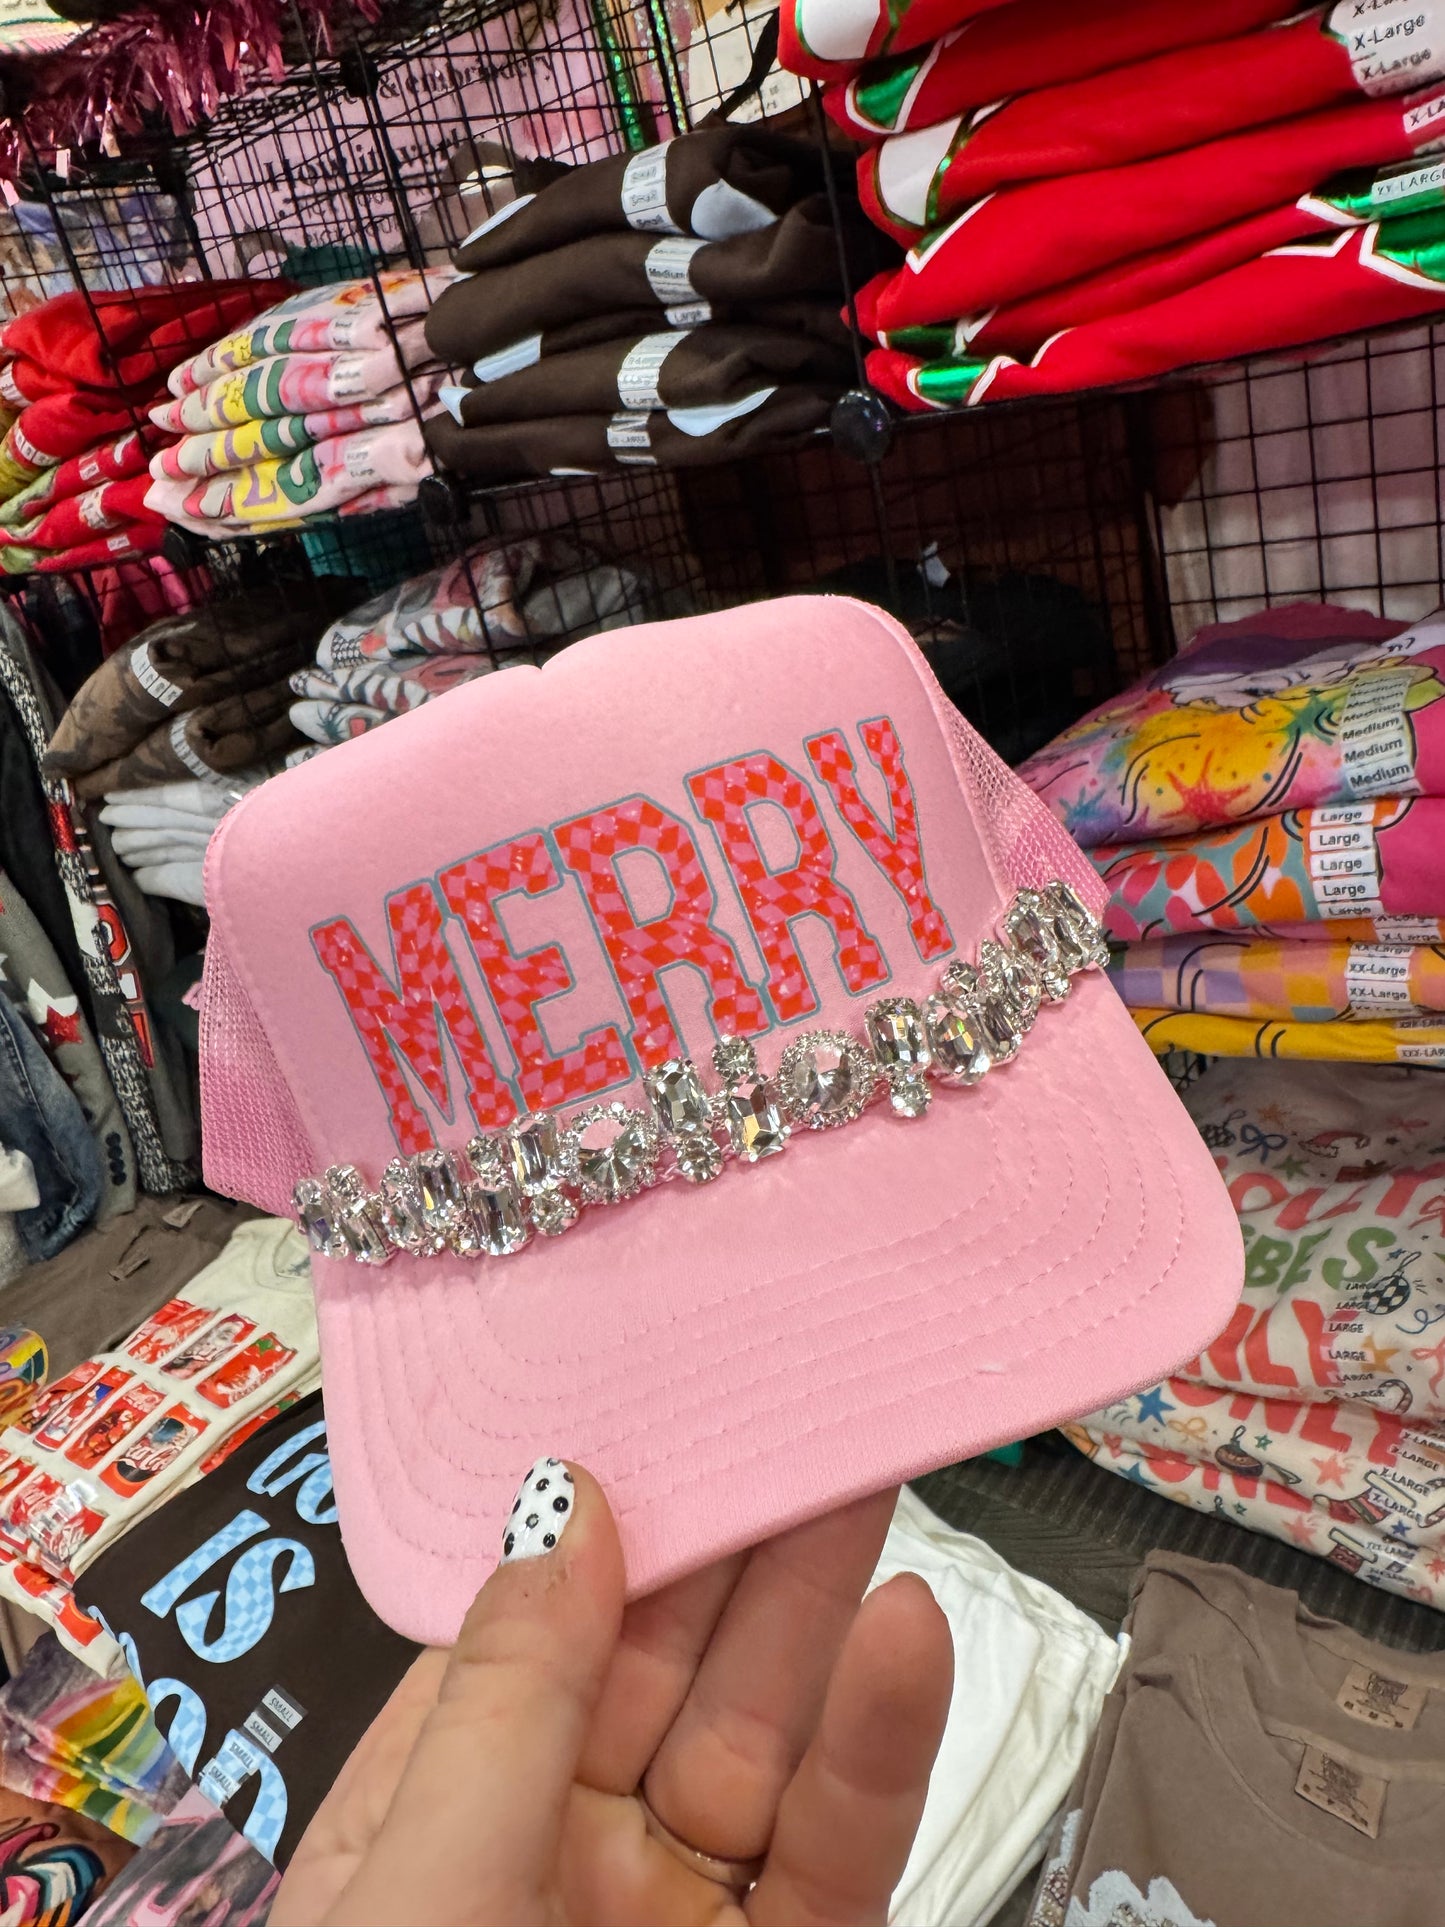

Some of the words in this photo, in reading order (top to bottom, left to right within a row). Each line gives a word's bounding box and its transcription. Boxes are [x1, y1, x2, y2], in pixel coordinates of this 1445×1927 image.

[1354, 14, 1425, 51] X-Large
[1361, 48, 1431, 80] X-Large
[1343, 717, 1400, 741] Medium
[1344, 738, 1403, 762] Medium
[1350, 764, 1411, 788] Medium
[1320, 811, 1362, 823] Large
[1320, 833, 1360, 847] Large
[1321, 859, 1362, 872] Large
[1323, 885, 1366, 897] Large
[309, 716, 955, 1158] MERRY
[1349, 963, 1407, 977] XX-Large
[1350, 987, 1408, 1001] XX-Large
[1329, 1322, 1364, 1333] LARGE
[1328, 1350, 1367, 1361] LARGE
[1381, 1467, 1431, 1497] X-LARGE
[1373, 1493, 1422, 1523] X-LARGE
[269, 1697, 294, 1722] SMALL
[250, 1720, 274, 1746] SMALL
[209, 1766, 232, 1791] SMALL
